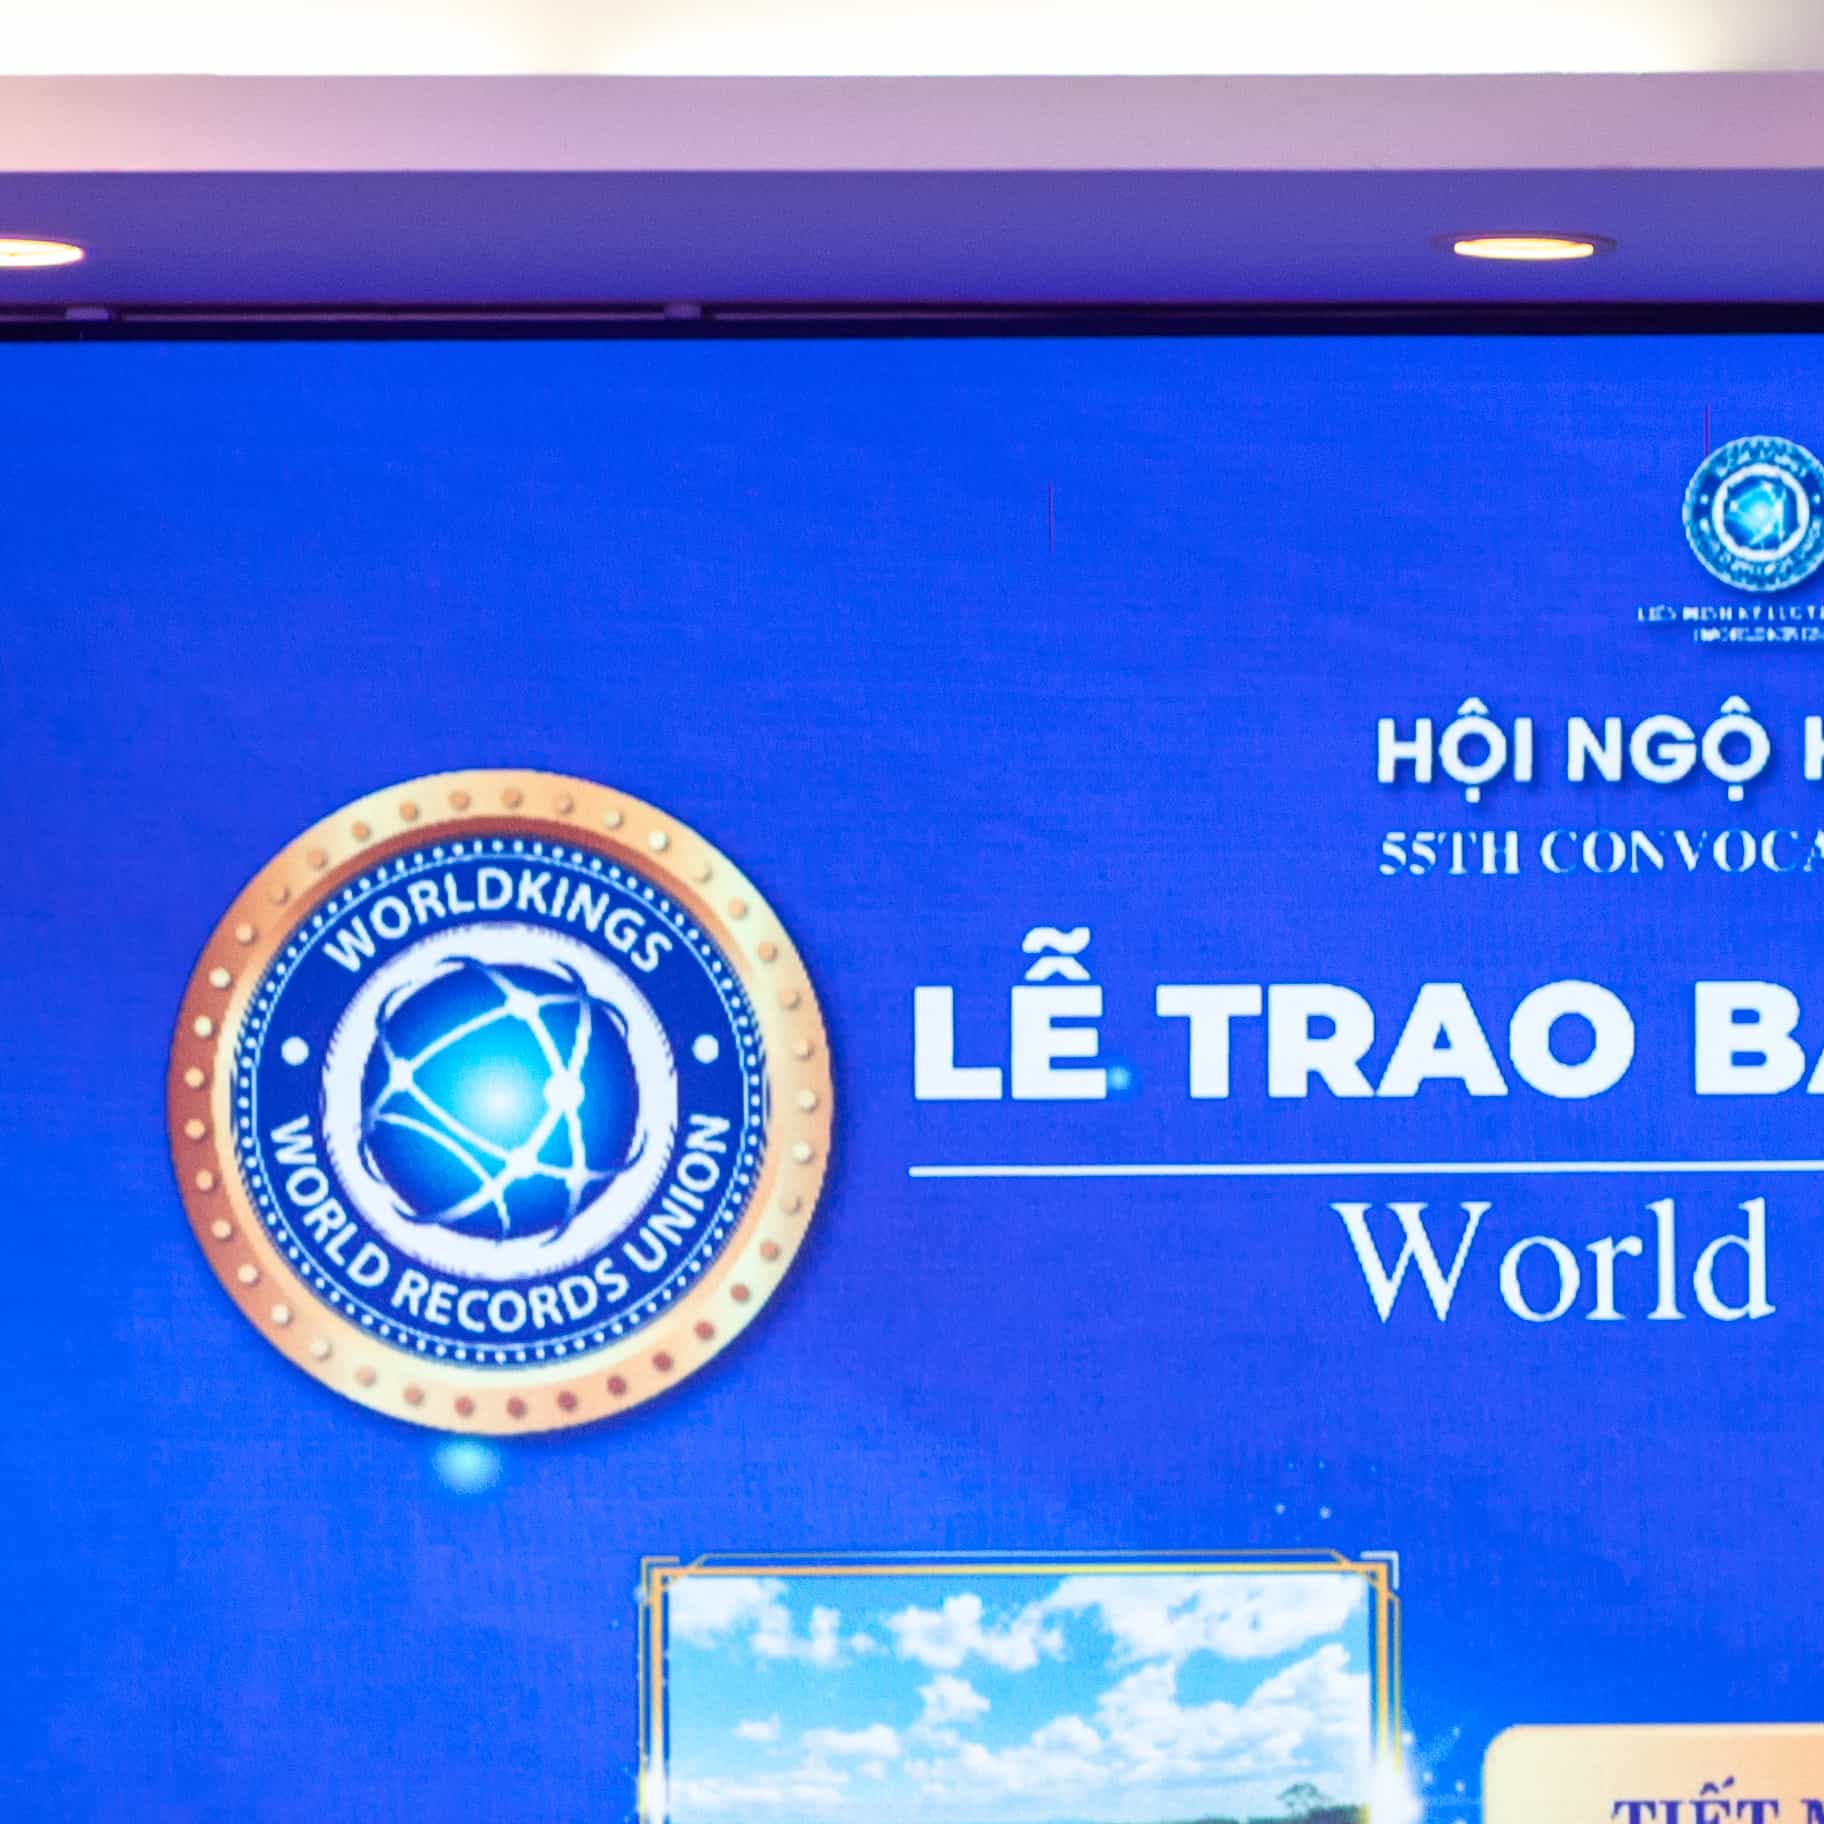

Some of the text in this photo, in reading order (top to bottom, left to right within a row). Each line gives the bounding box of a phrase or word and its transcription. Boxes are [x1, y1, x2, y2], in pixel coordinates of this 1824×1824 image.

[1378, 697, 1532, 803] HỘI
[1566, 695, 1771, 801] NGỘ
[1379, 831, 1519, 875] 55TH
[323, 866, 675, 973] WORLDKINGS
[914, 927, 1108, 1099] LỄ
[1156, 980, 1635, 1098] TRAO
[270, 1113, 731, 1334] WORLD RECORDS UNION
[1333, 1198, 1775, 1322] World
